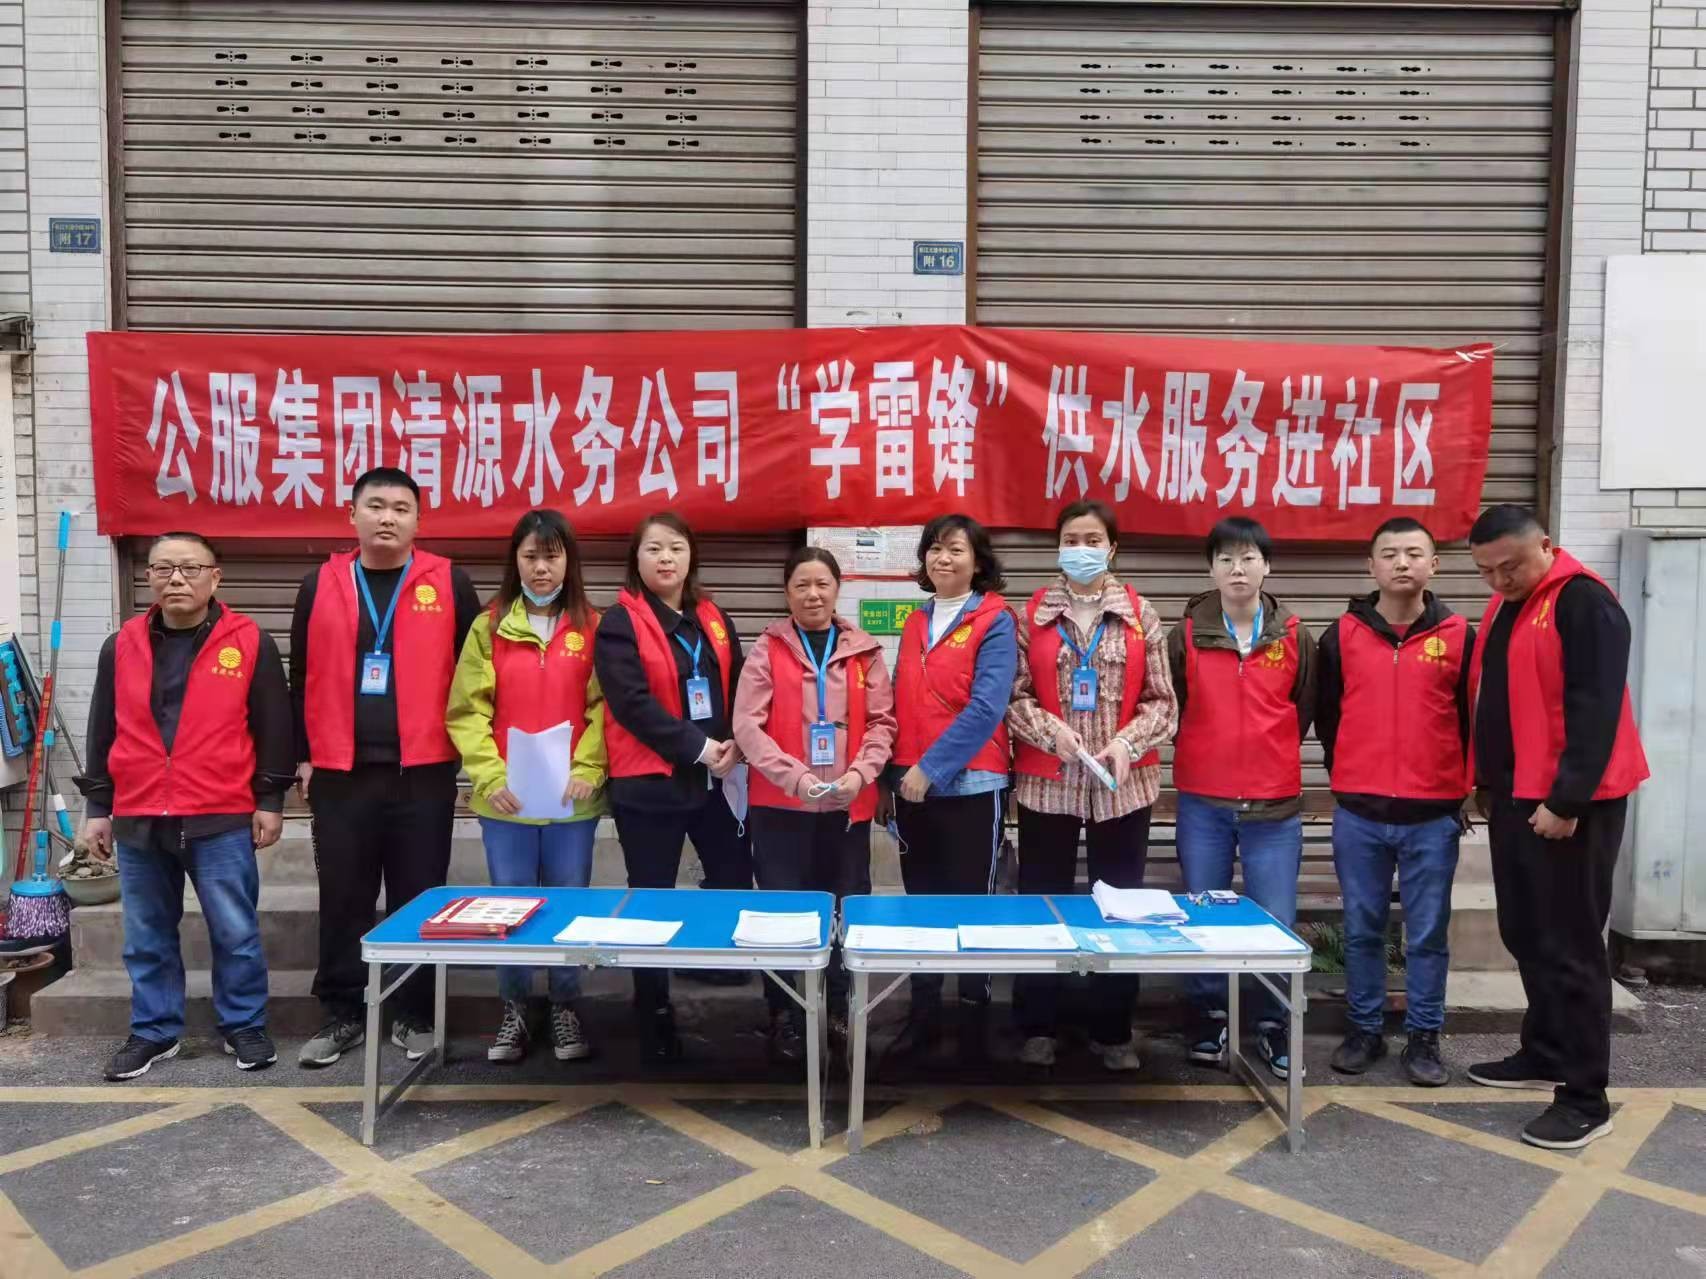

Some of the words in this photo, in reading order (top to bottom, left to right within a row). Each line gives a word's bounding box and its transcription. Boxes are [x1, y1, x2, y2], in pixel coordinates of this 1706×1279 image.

[75, 232, 92, 247] 17
[940, 255, 955, 268] 16
[145, 365, 741, 508] 公服集团清源水务公司
[1041, 364, 1440, 511] 供水服务进社区
